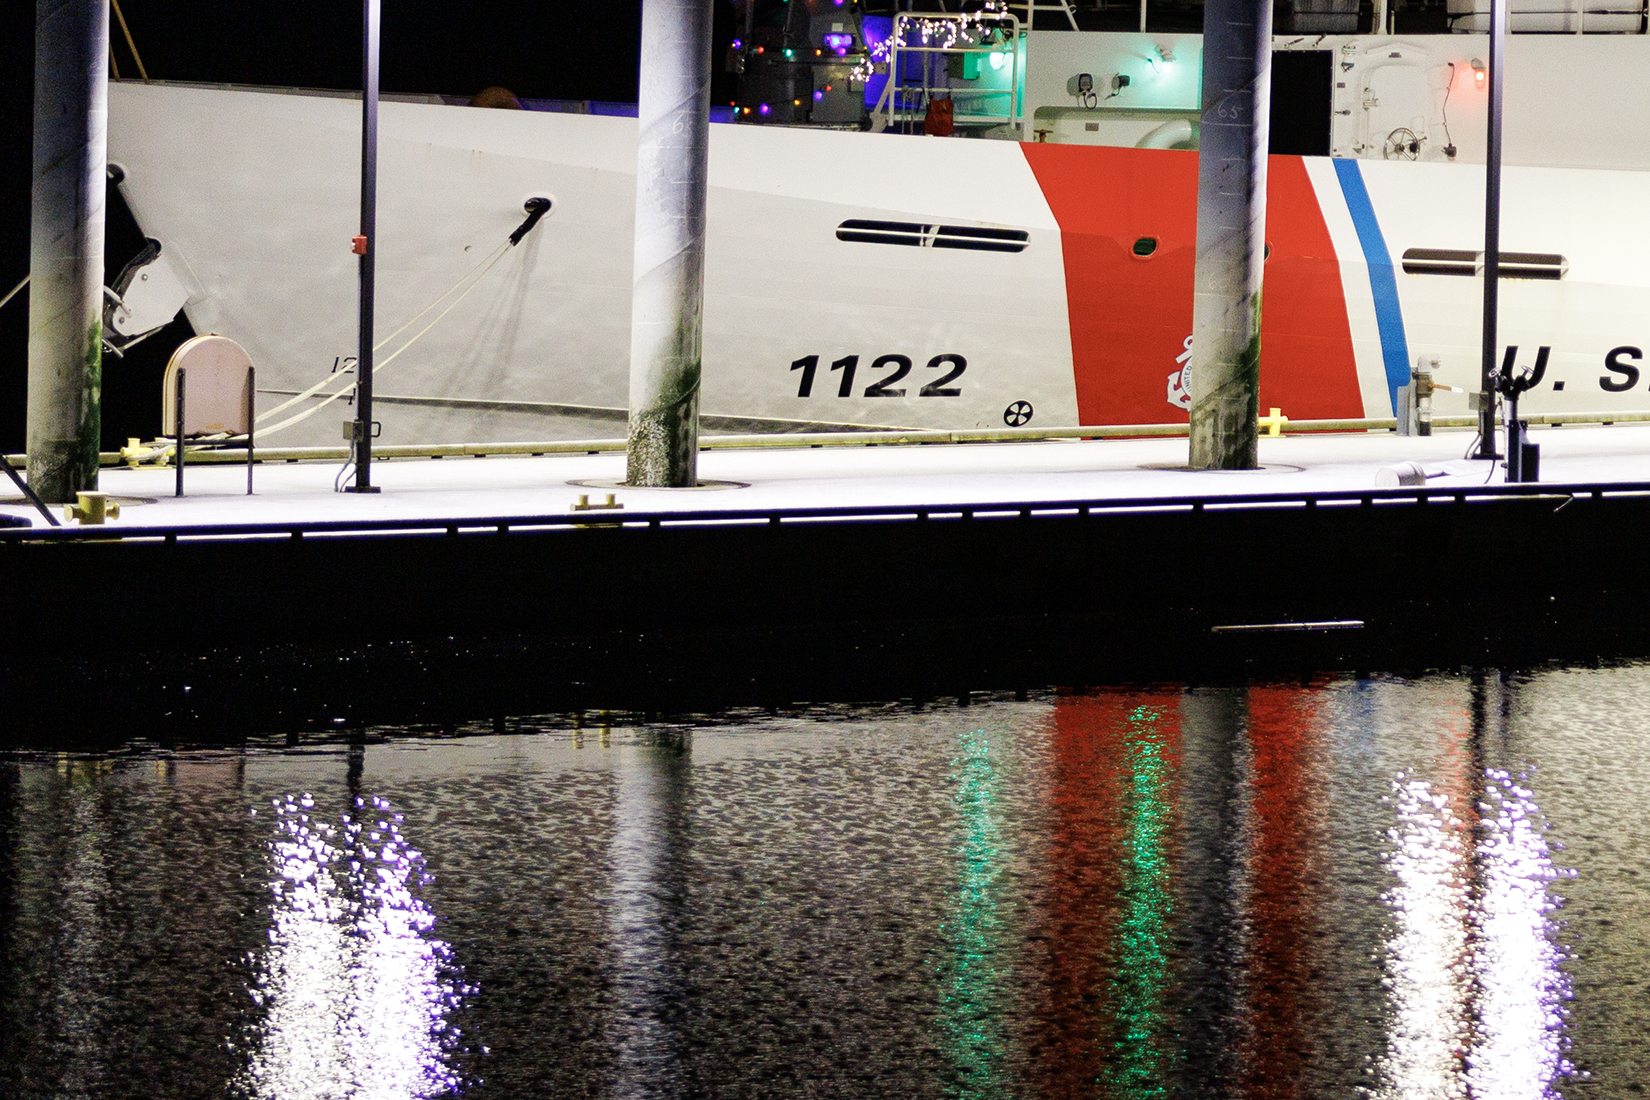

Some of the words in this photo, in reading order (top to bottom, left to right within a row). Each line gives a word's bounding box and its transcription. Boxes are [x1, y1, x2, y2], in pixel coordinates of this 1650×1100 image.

[331, 356, 357, 373] 12
[790, 353, 968, 398] 1122
[1500, 346, 1565, 392] U.
